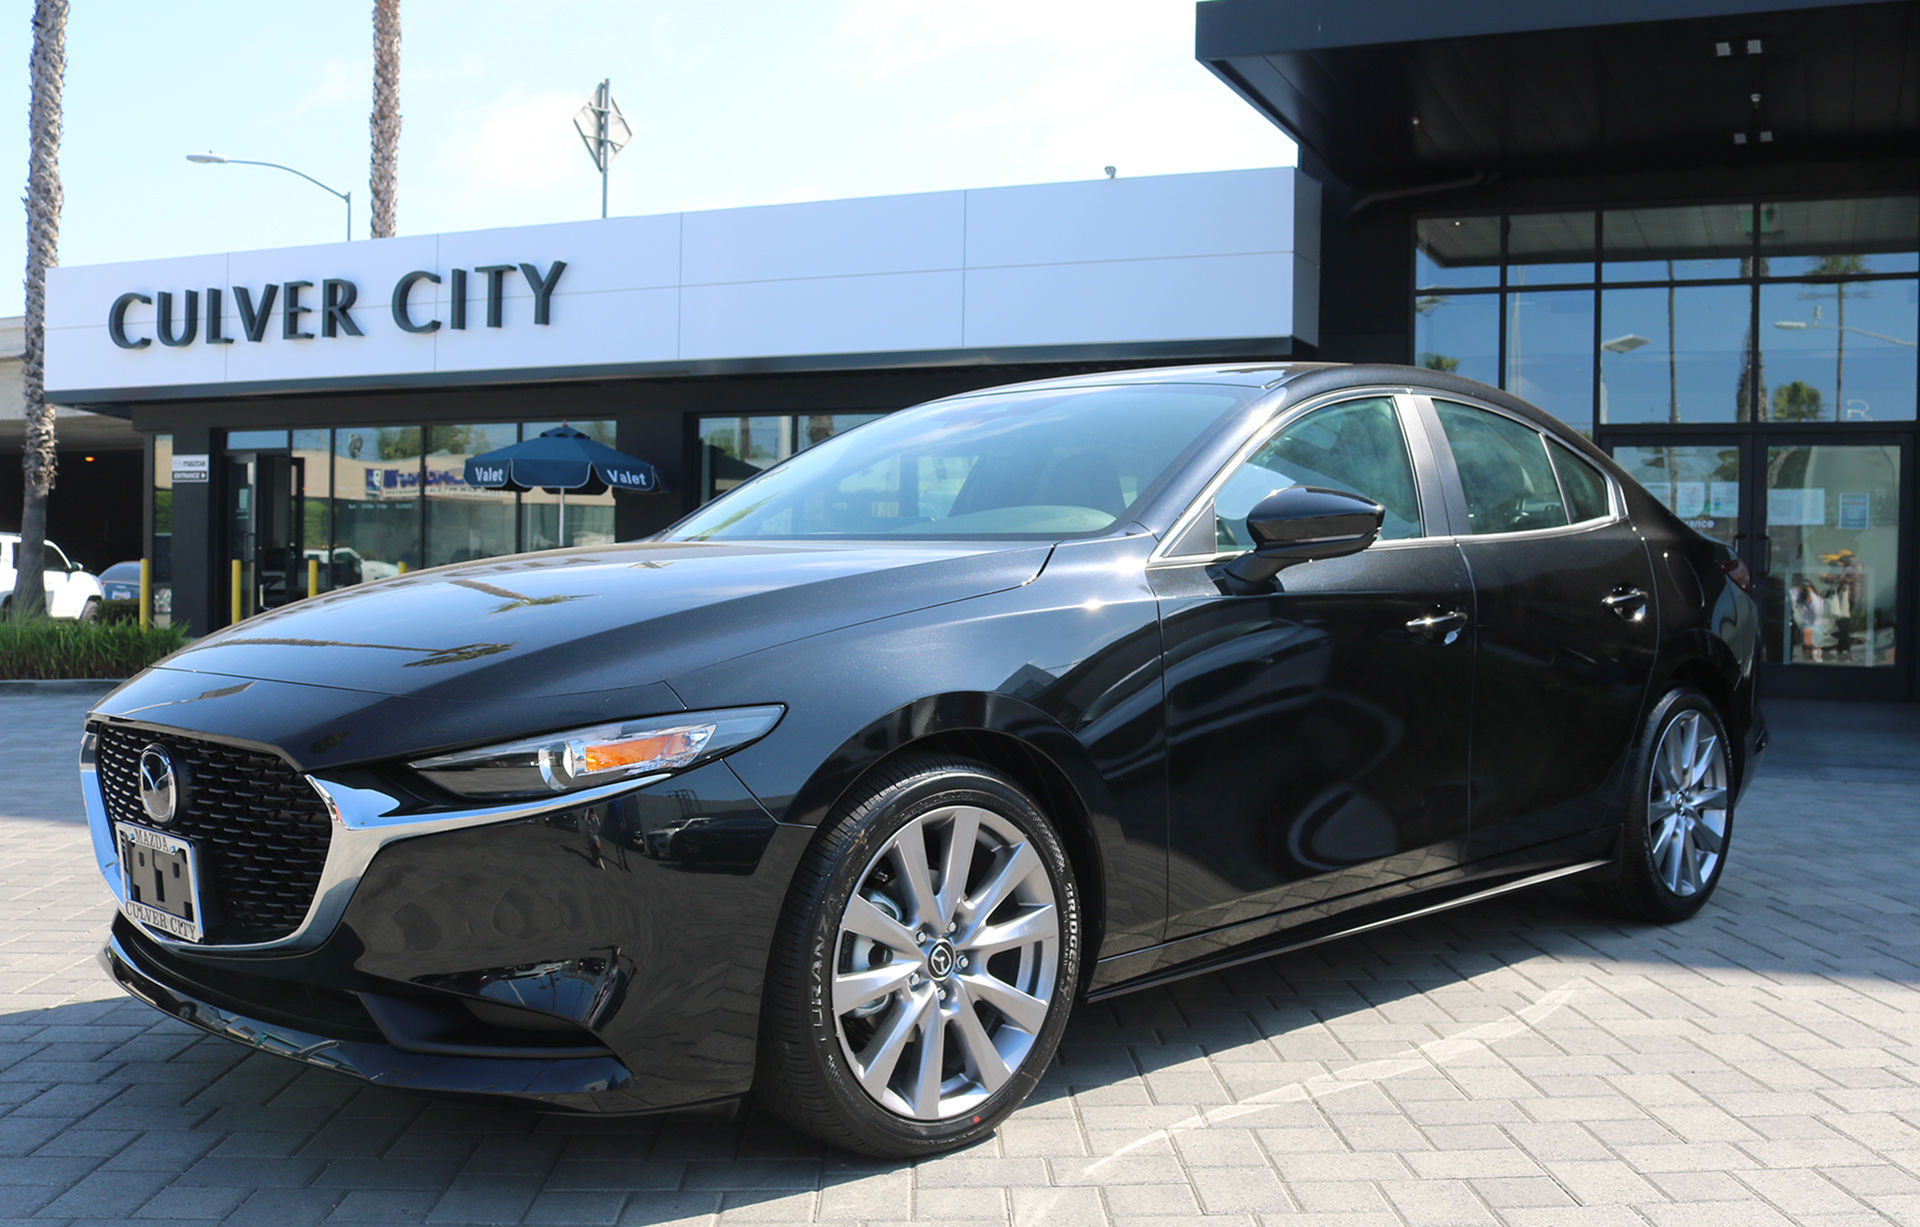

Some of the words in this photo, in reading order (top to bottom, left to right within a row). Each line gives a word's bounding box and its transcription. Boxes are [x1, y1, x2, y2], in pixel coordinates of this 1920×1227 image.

[108, 278, 365, 350] CULVER
[391, 260, 568, 334] CITY
[475, 467, 504, 482] Valet
[607, 469, 647, 486] Valet
[1682, 518, 1715, 529] rance
[134, 828, 169, 852] MAZDA
[126, 901, 168, 929] CULVER
[169, 917, 196, 940] CITY
